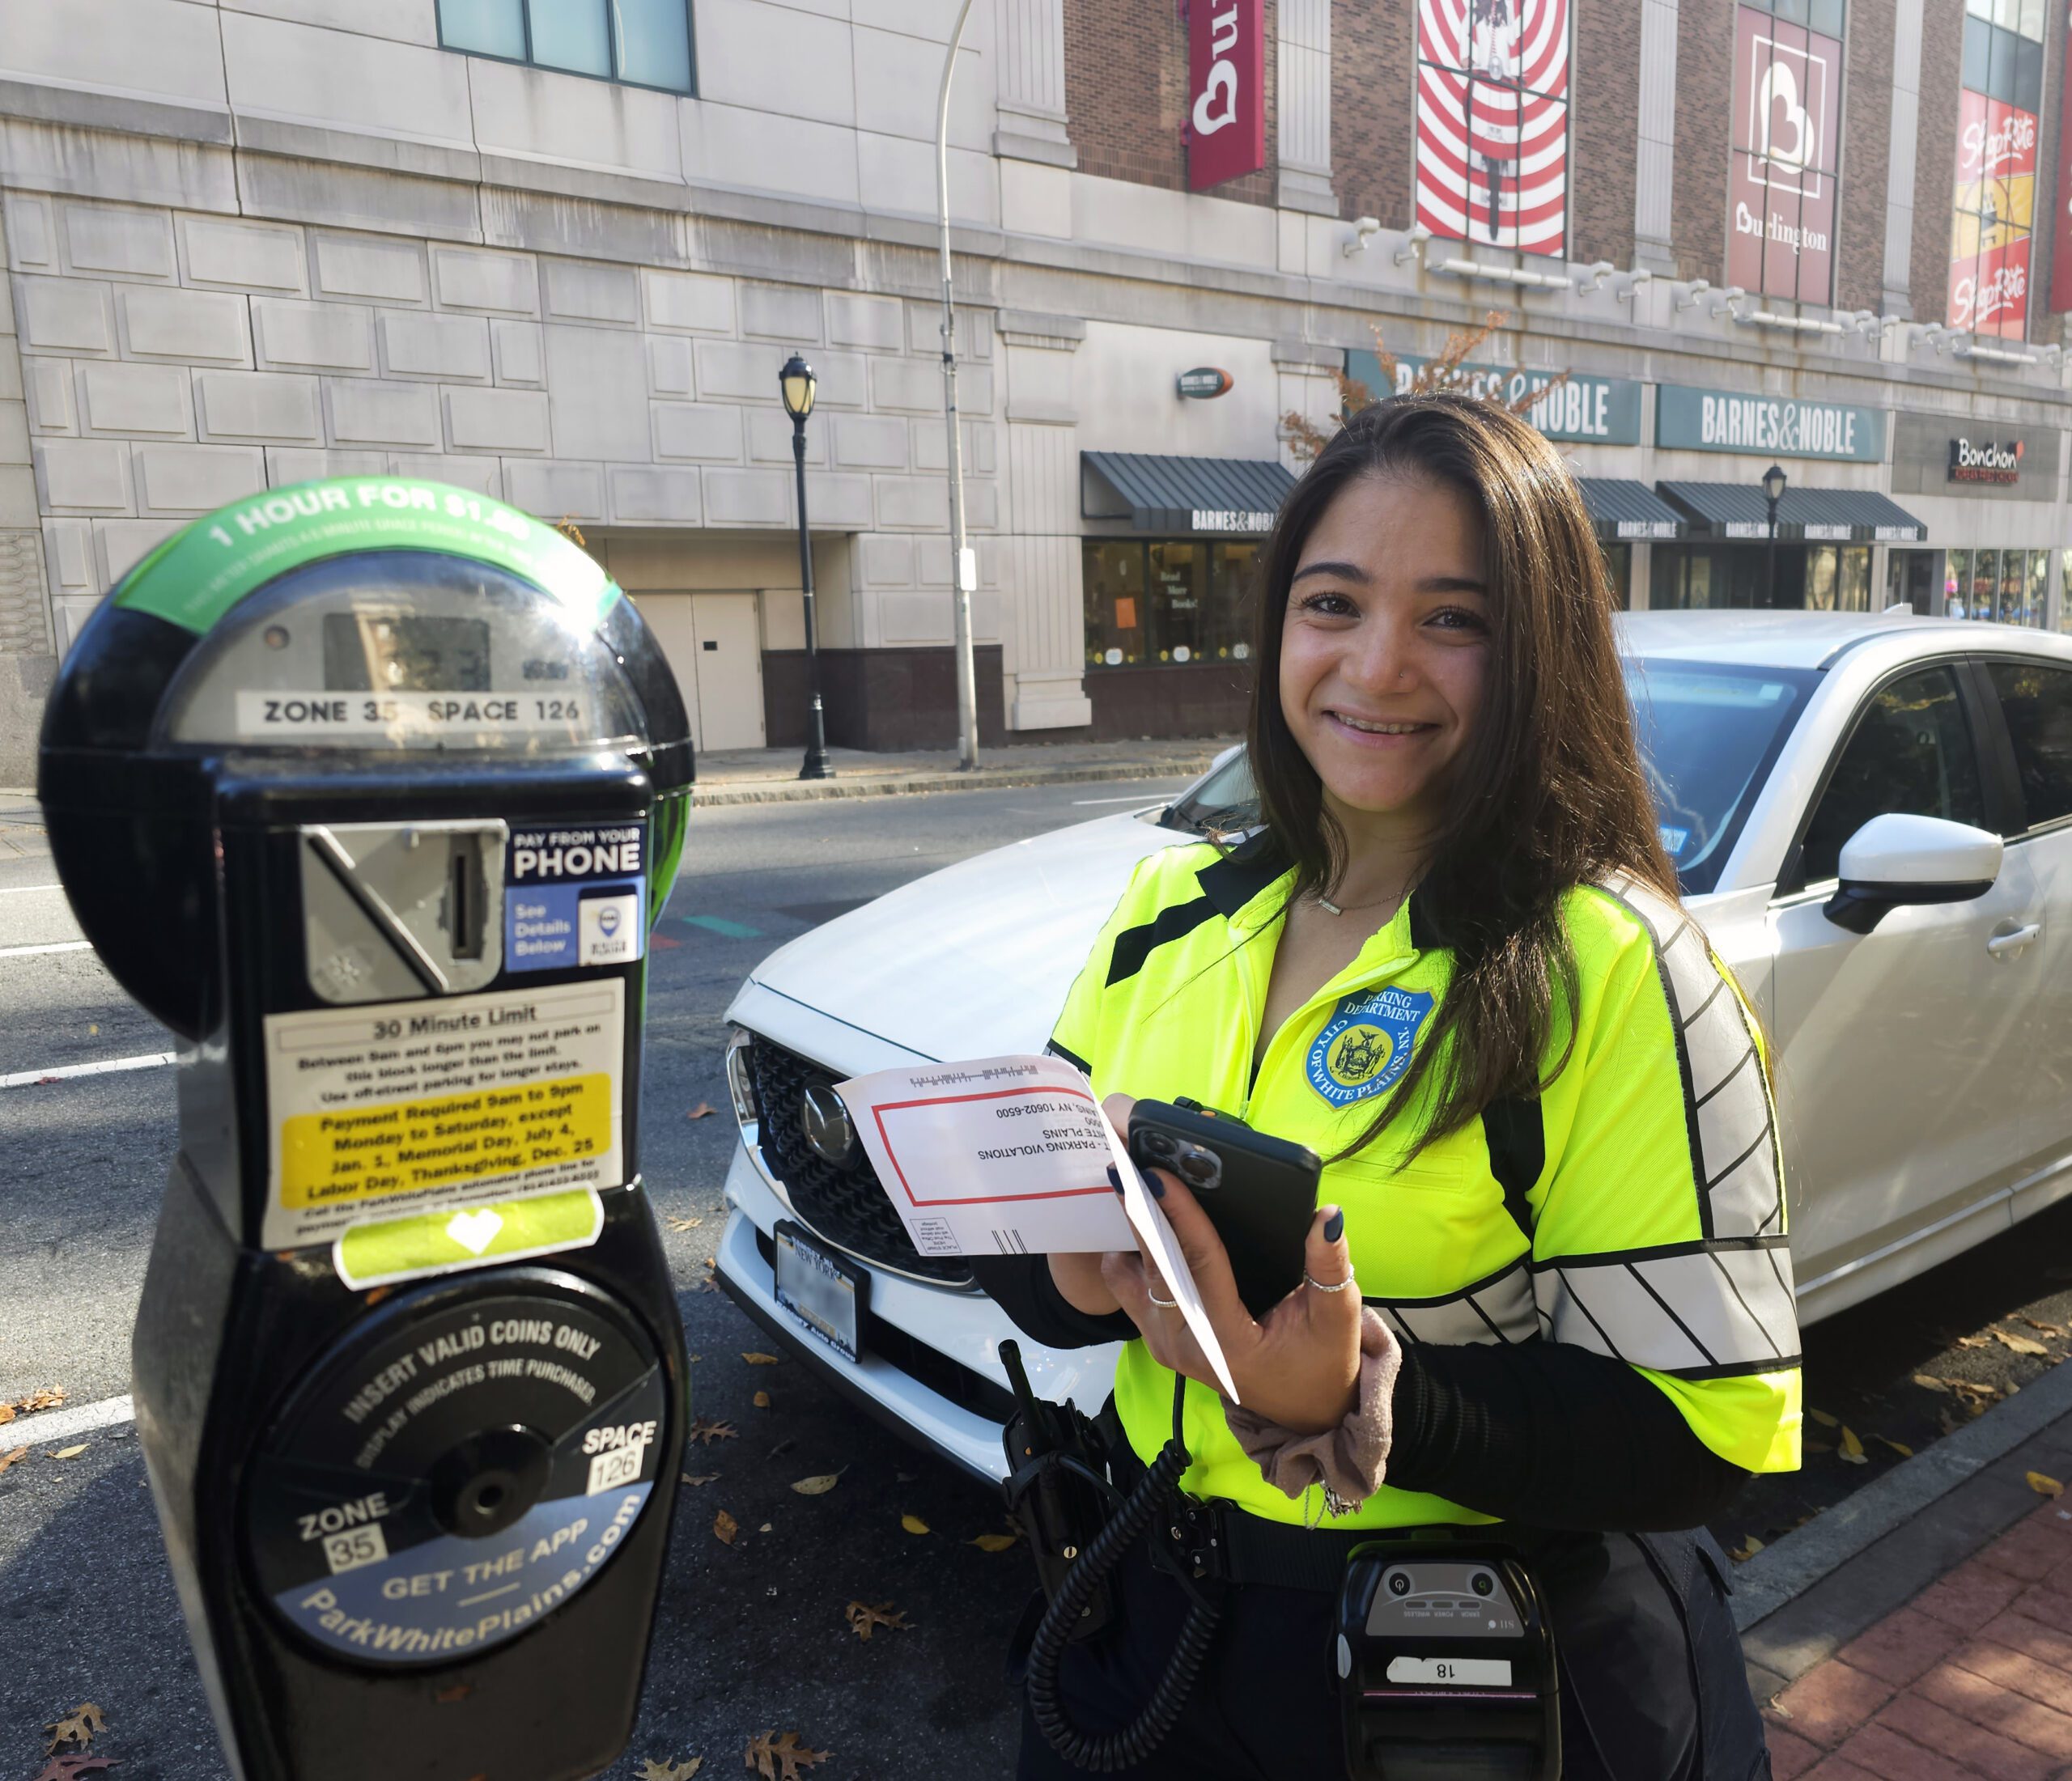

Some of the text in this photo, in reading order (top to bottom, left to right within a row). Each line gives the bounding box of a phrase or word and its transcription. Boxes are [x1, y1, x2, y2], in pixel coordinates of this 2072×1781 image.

[1192, 0, 1238, 135] Bu
[1962, 115, 2034, 168] ShopRite
[1736, 201, 1827, 255] Burlington
[1953, 261, 2025, 324] ShopRite
[1701, 395, 1856, 454] BARNES&NOBLE
[1959, 438, 2017, 469] Bonchon
[210, 525, 233, 547] 1
[235, 487, 350, 535] HOUR
[357, 484, 436, 511] FOR
[1192, 510, 1275, 532] BARNES&NOBL
[1161, 571, 1180, 582] Read
[1167, 585, 1187, 595] More
[1171, 599, 1198, 609] Books!
[265, 700, 580, 723] ZONE 35 SPACE 126
[514, 827, 640, 848] PAY FROM YOUR
[514, 842, 640, 878] PHONE
[514, 904, 546, 919] See
[514, 919, 571, 939] Details
[515, 939, 567, 956] Below
[1344, 1001, 1420, 1022] DEARTMENT
[1363, 990, 1412, 1008] PRKING
[373, 1004, 537, 1041] 30 Minute Limit
[1317, 1020, 1348, 1049] CITY
[298, 1054, 364, 1071] Between
[405, 1045, 431, 1059] and
[470, 1038, 493, 1052] you
[497, 1034, 524, 1049] may
[529, 1029, 549, 1042] not
[553, 1026, 582, 1041] park
[585, 1024, 600, 1033] on
[1311, 1050, 1323, 1066] OF
[346, 1071, 373, 1083] this
[378, 1065, 417, 1080] block
[422, 1058, 464, 1073] longer
[469, 1054, 499, 1068] than
[503, 1050, 524, 1062] the
[1312, 1066, 1355, 1100] WHITE
[321, 1092, 348, 1104] Use
[354, 1081, 418, 1099] off-street
[422, 1074, 474, 1094] parking
[479, 1071, 495, 1083] for
[501, 1066, 541, 1079] longer
[320, 1083, 584, 1132] Payment Required 9am to 9pm
[996, 1102, 1097, 1119] AINS, NY 10602-6500
[1085, 1117, 1103, 1128] 500
[333, 1104, 573, 1152] Monday to Saturday, except
[1042, 1128, 1107, 1139] HITE PLAINS
[331, 1122, 575, 1174] Jan. 1, Memorial Day, July 4,
[978, 1143, 1044, 1160] VIOLATIONS
[1046, 1141, 1096, 1153] PARKING
[307, 1182, 359, 1201] Labor
[365, 1174, 405, 1190] Day,
[411, 1153, 526, 1182] Thanksgiving,
[532, 1147, 568, 1162] Dec.
[574, 1138, 593, 1154] 25
[335, 1202, 355, 1214] the
[461, 1172, 520, 1191] automated
[524, 1166, 556, 1180] phone
[559, 1161, 578, 1172] line
[582, 1158, 595, 1168] for
[795, 1244, 815, 1267] NEW
[814, 1259, 838, 1282] YORK
[811, 1326, 856, 1363] Auto Group
[343, 1319, 601, 1423] INSERT VALID COINS ONLY
[405, 1364, 486, 1415] INDICATES
[487, 1358, 525, 1378] TIME
[526, 1359, 597, 1406] PURCHASED
[582, 1421, 657, 1454] SPACE
[597, 1449, 635, 1486] 126
[297, 1491, 389, 1541] ZONE
[329, 1534, 377, 1568] 35
[382, 1517, 589, 1601] GET THE APP
[300, 1494, 641, 1653] ParkWhitePlains.com
[1437, 1664, 1455, 1678] 18
